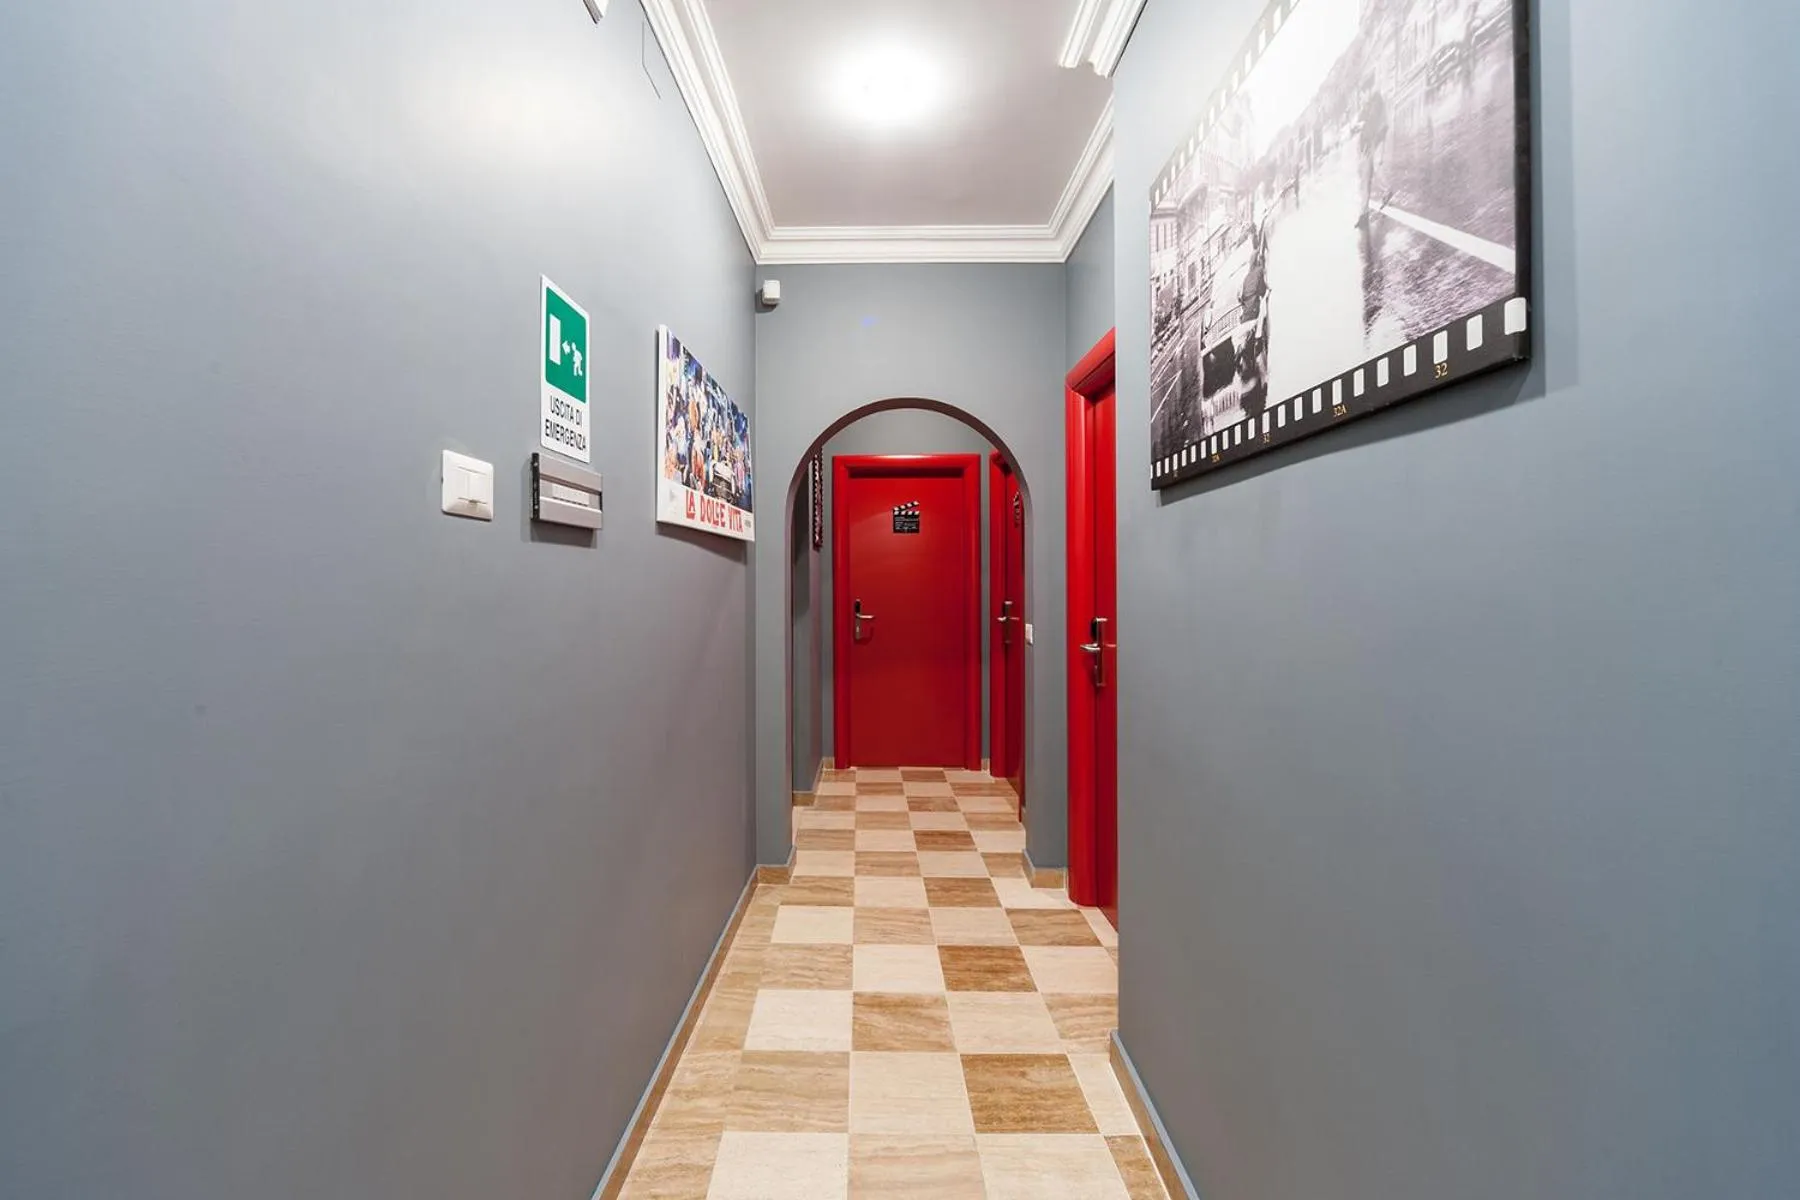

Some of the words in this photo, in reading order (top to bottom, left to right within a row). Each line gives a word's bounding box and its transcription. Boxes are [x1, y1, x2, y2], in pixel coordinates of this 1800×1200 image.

[1434, 362, 1448, 379] 32
[549, 395, 574, 424] USCITA
[576, 408, 583, 428] DI
[545, 418, 586, 451] EMERGENZA
[685, 489, 696, 520] LA
[700, 495, 726, 528] DOLCE
[728, 506, 744, 533] VITA
